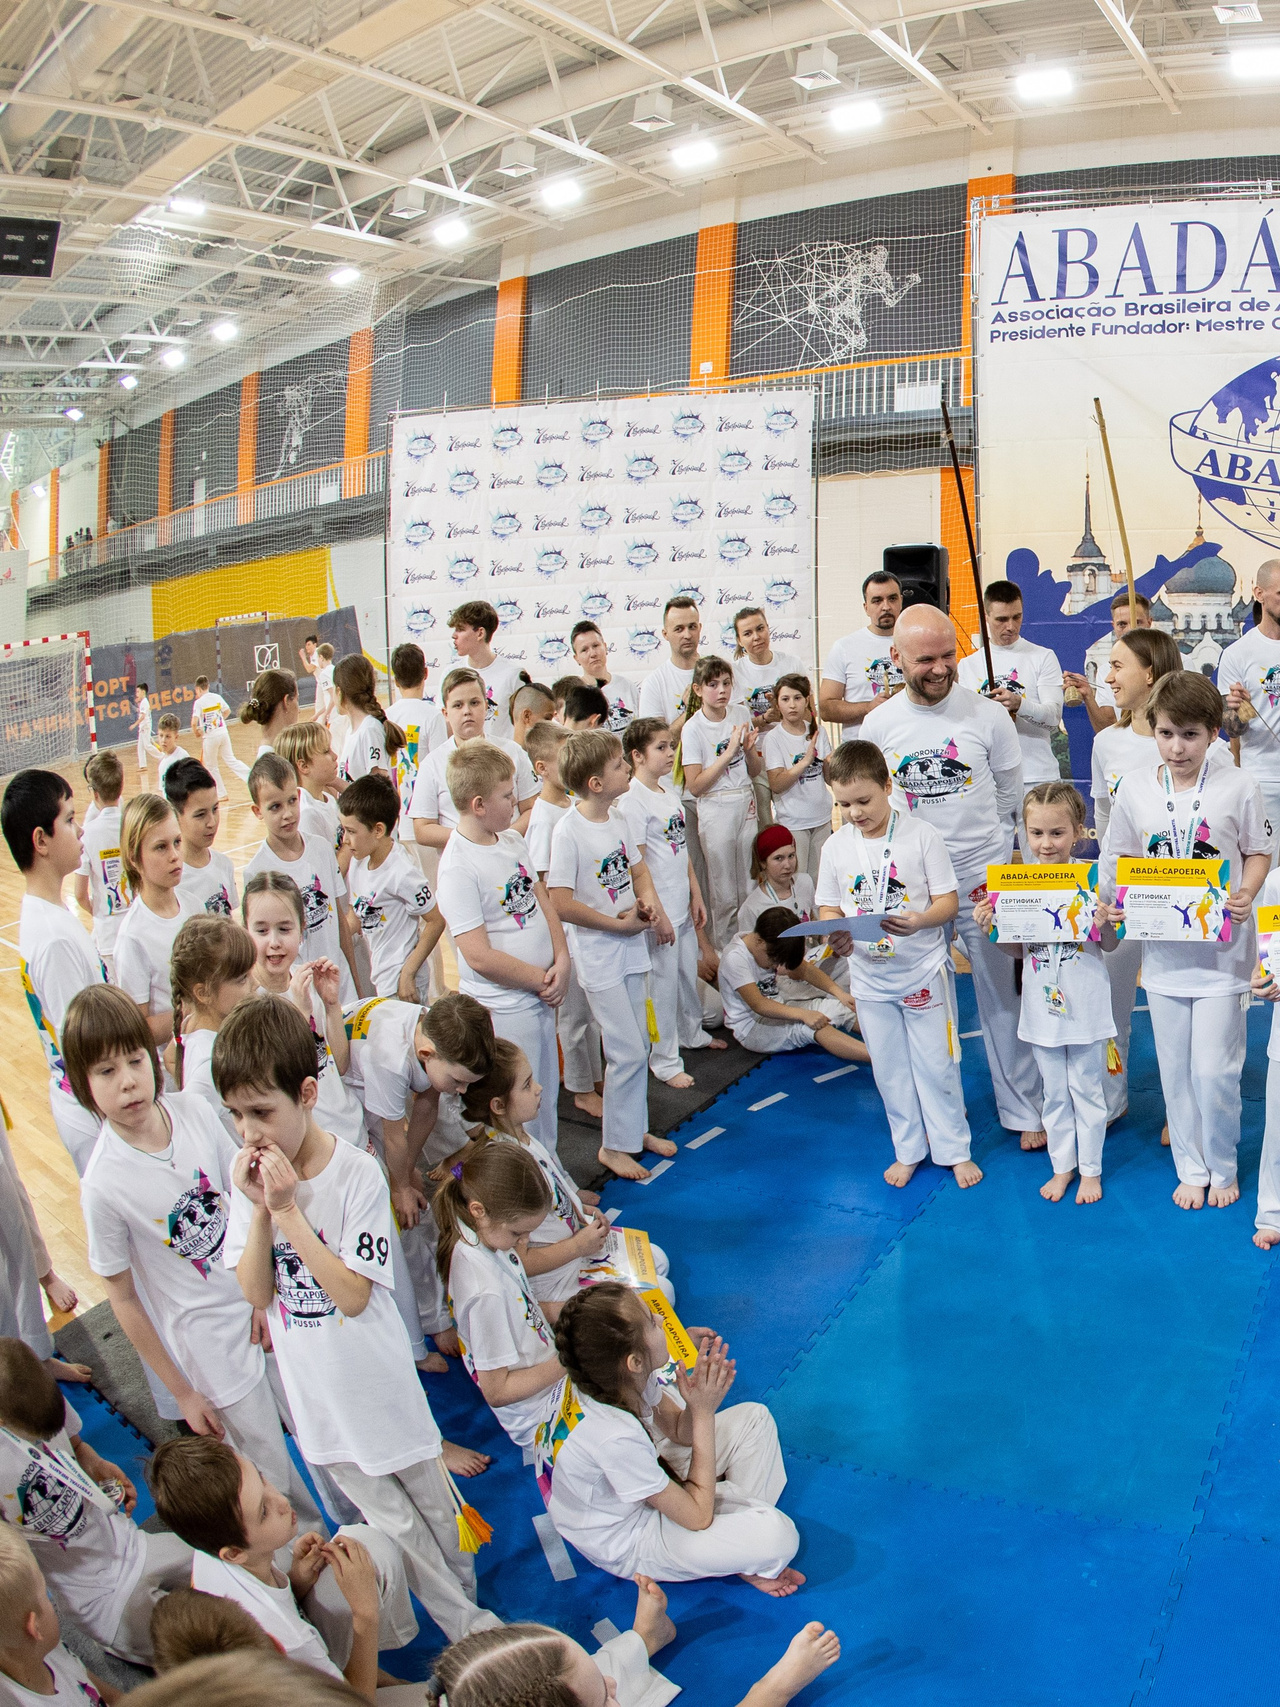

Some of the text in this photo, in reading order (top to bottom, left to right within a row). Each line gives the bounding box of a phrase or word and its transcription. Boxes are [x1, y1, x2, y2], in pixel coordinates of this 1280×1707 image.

[991, 300, 1117, 325] Associação
[1124, 298, 1232, 317] Brasileira
[1239, 297, 1271, 313] de
[990, 323, 1086, 343] Presidente
[1091, 318, 1190, 337] Fundador:
[1196, 317, 1265, 333] Mestre
[909, 748, 950, 759] VORONEZH
[921, 797, 947, 805] RUSSIA
[1000, 871, 1076, 880] ABADÁ-CAPOEIRA
[1129, 866, 1206, 875] ABADÁ-CAPOEIRA
[414, 885, 432, 907] 58
[355, 1231, 389, 1266] 89
[293, 1318, 322, 1328] RUSSIA
